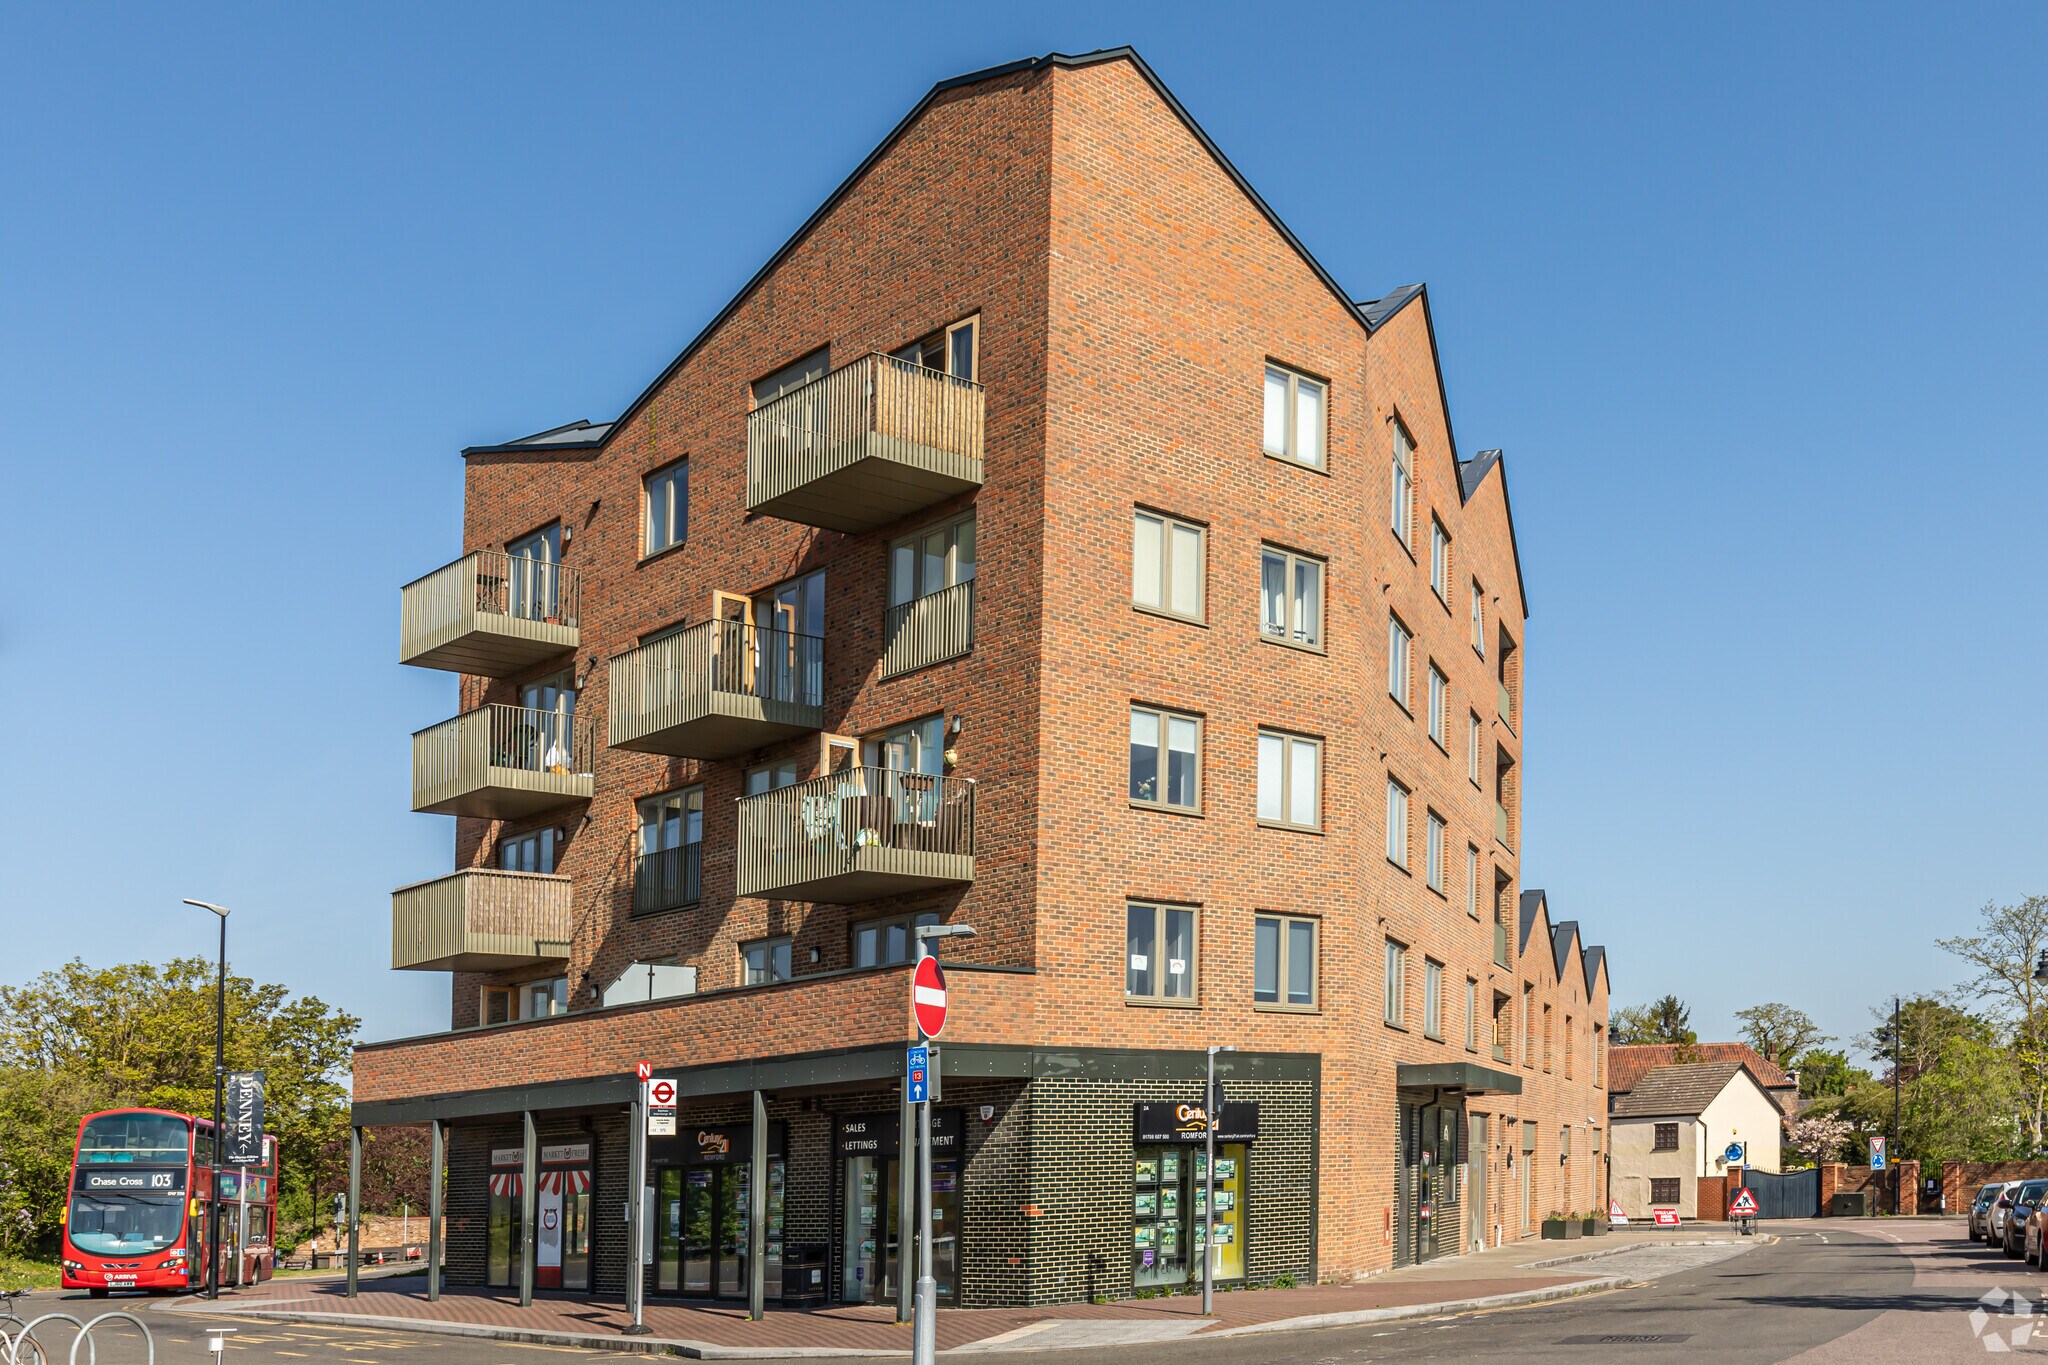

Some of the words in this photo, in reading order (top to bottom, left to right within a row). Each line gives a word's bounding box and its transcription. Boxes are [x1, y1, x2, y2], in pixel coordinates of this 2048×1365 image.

[639, 1064, 650, 1077] N
[238, 1076, 253, 1144] DENNEY
[846, 1123, 866, 1133] SALES
[698, 1131, 721, 1146] Century
[845, 1140, 878, 1150] LETTINGS
[91, 1177, 116, 1185] Chase
[120, 1177, 144, 1185] Cross
[152, 1174, 172, 1187] 103
